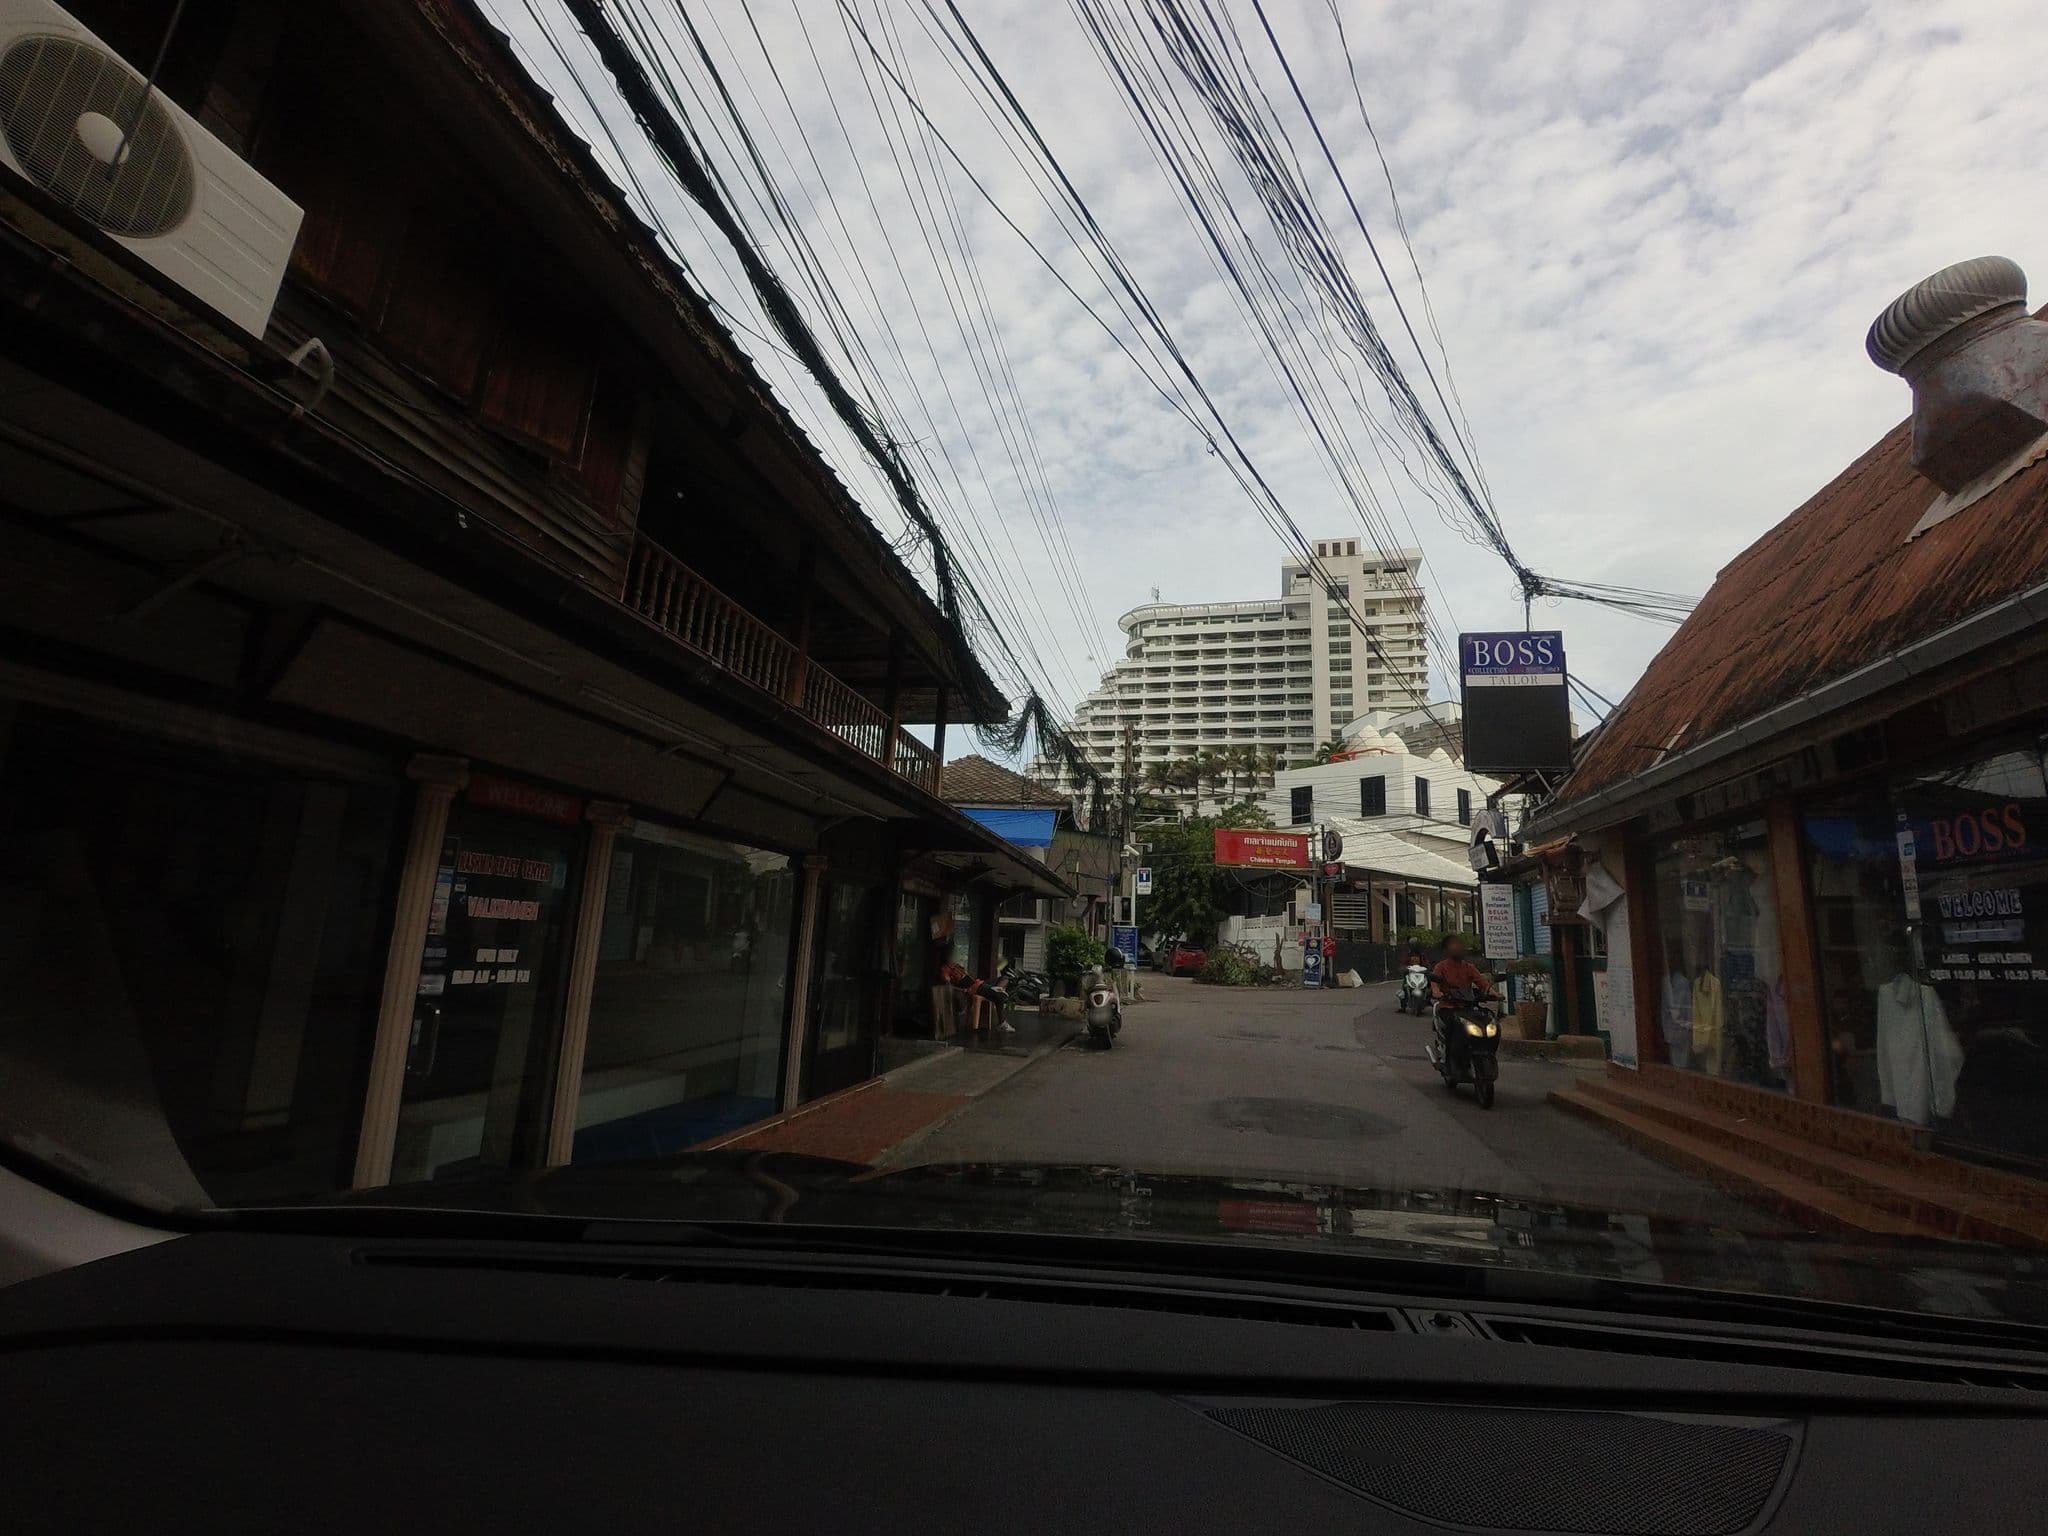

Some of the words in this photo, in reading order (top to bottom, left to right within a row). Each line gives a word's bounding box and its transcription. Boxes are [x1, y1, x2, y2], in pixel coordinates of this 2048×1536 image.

[1473, 639, 1554, 666] BOSS
[1489, 675, 1539, 686] TAILOR
[1930, 803, 2028, 864] BOSS
[1249, 856, 1274, 864] Chinese
[1275, 857, 1297, 865] Temple
[1938, 887, 2023, 919] WELCOME
[1942, 952, 1971, 964] LADIES
[1977, 952, 2033, 965] GENTLEMEN
[1930, 969, 1951, 981] OPEN
